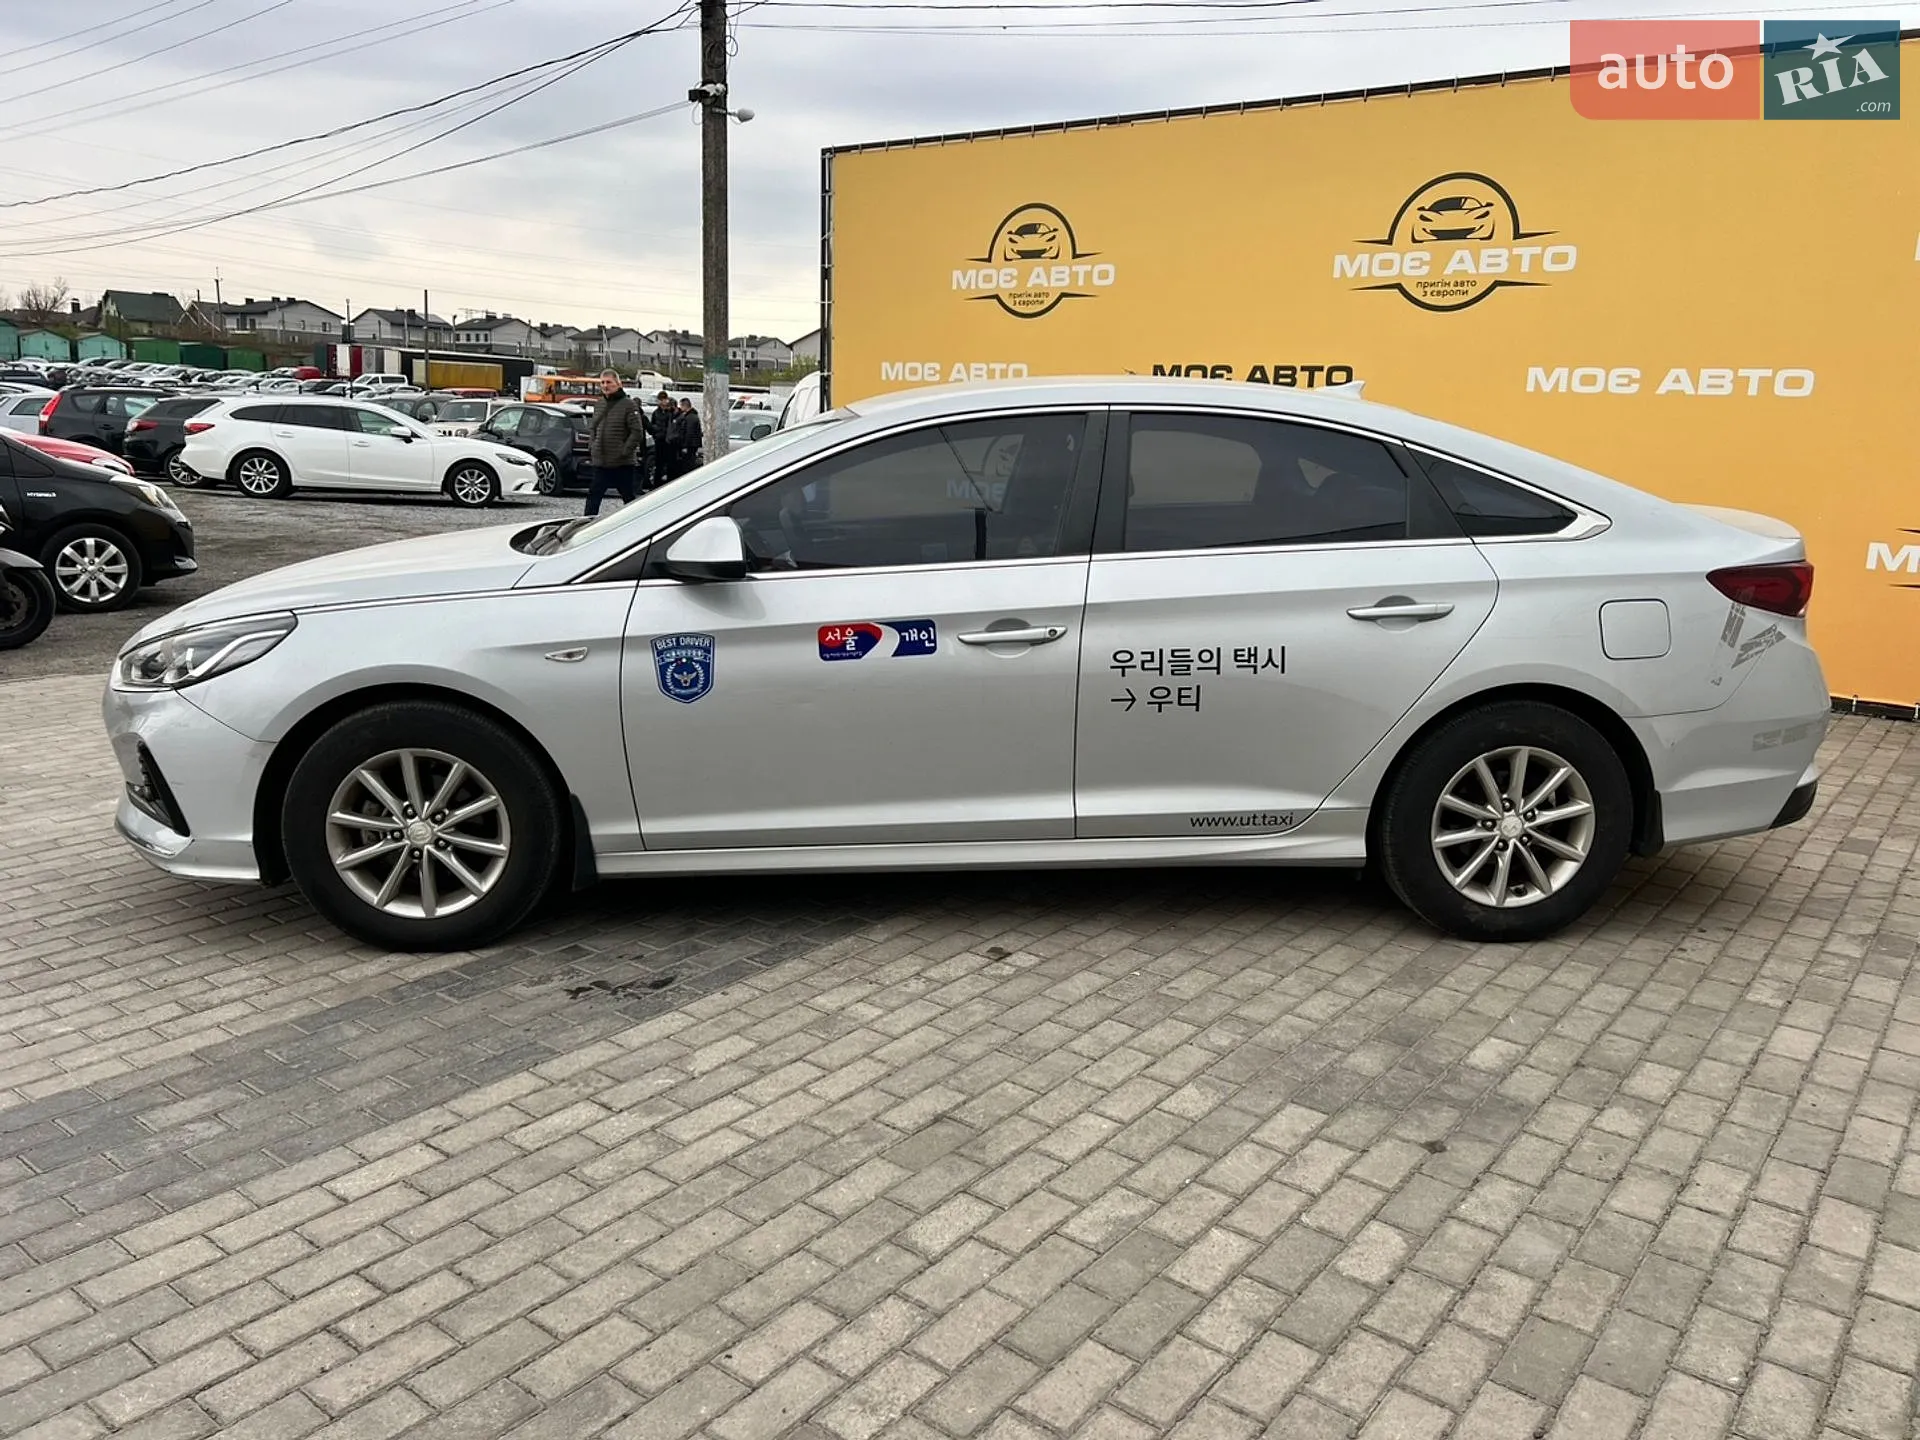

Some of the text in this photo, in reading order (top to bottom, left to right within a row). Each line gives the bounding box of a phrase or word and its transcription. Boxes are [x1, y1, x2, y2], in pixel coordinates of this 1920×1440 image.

[1332, 244, 1578, 279] МОЄ АВТО
[951, 263, 1116, 290] МОЄ АВТО
[1454, 279, 1477, 287] авто
[880, 361, 1028, 383] МОЄ АВТО
[1246, 365, 1354, 388] АВТО
[1526, 367, 1815, 397] МОЄ АВТО
[655, 636, 711, 650] BEST DRIVER
[825, 626, 935, 651] 서울 개인
[1109, 645, 1286, 678] 우리들의 택시
[1146, 684, 1201, 713] 우티
[1190, 811, 1294, 828] www.ut.taxi
